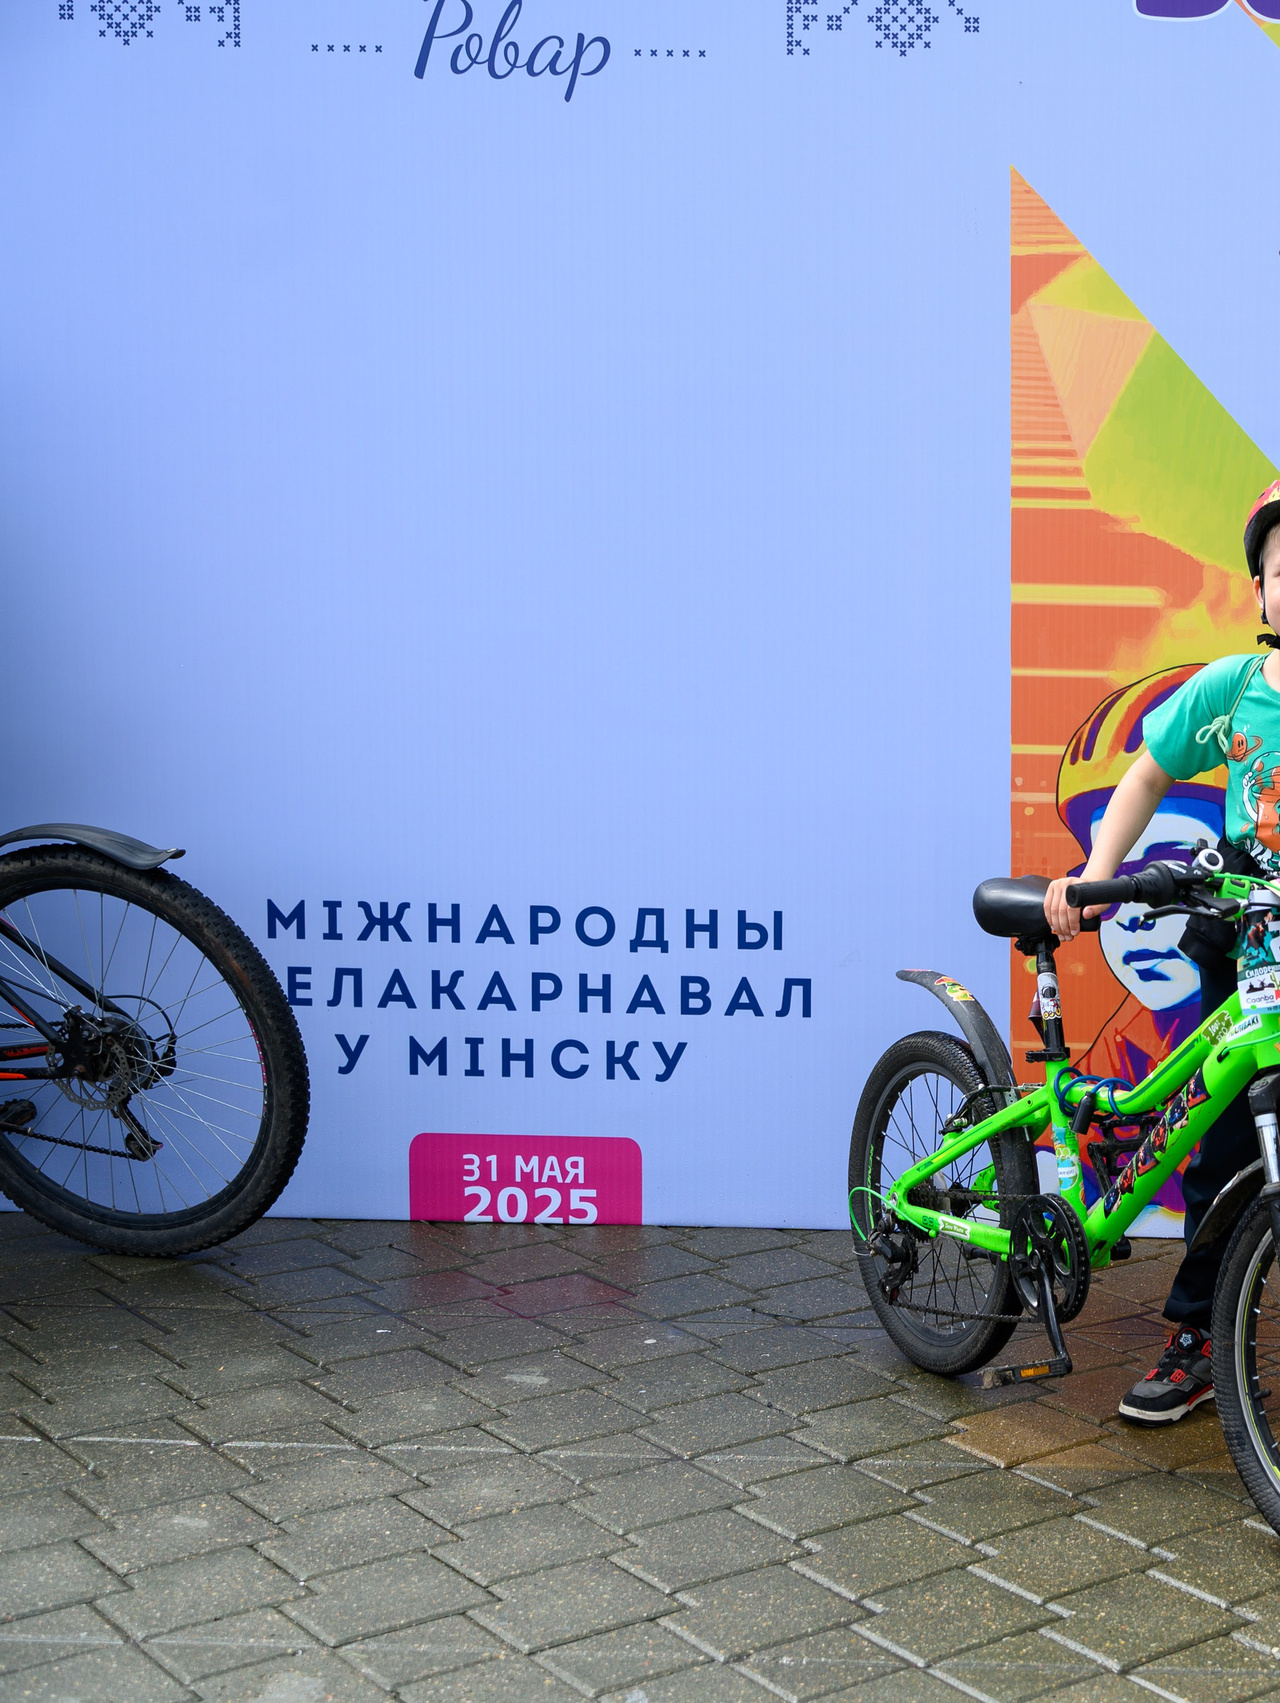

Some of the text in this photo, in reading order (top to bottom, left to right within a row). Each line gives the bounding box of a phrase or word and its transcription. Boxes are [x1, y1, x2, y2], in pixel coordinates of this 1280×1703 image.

[266, 898, 784, 954] МІЖНАРОДНЫ
[287, 966, 812, 1018] ЕЛАКАРНАВАЛ
[334, 1033, 688, 1082] У МІНСКУ
[462, 1153, 585, 1184] 31 МАЯ
[463, 1185, 599, 1225] 2025
